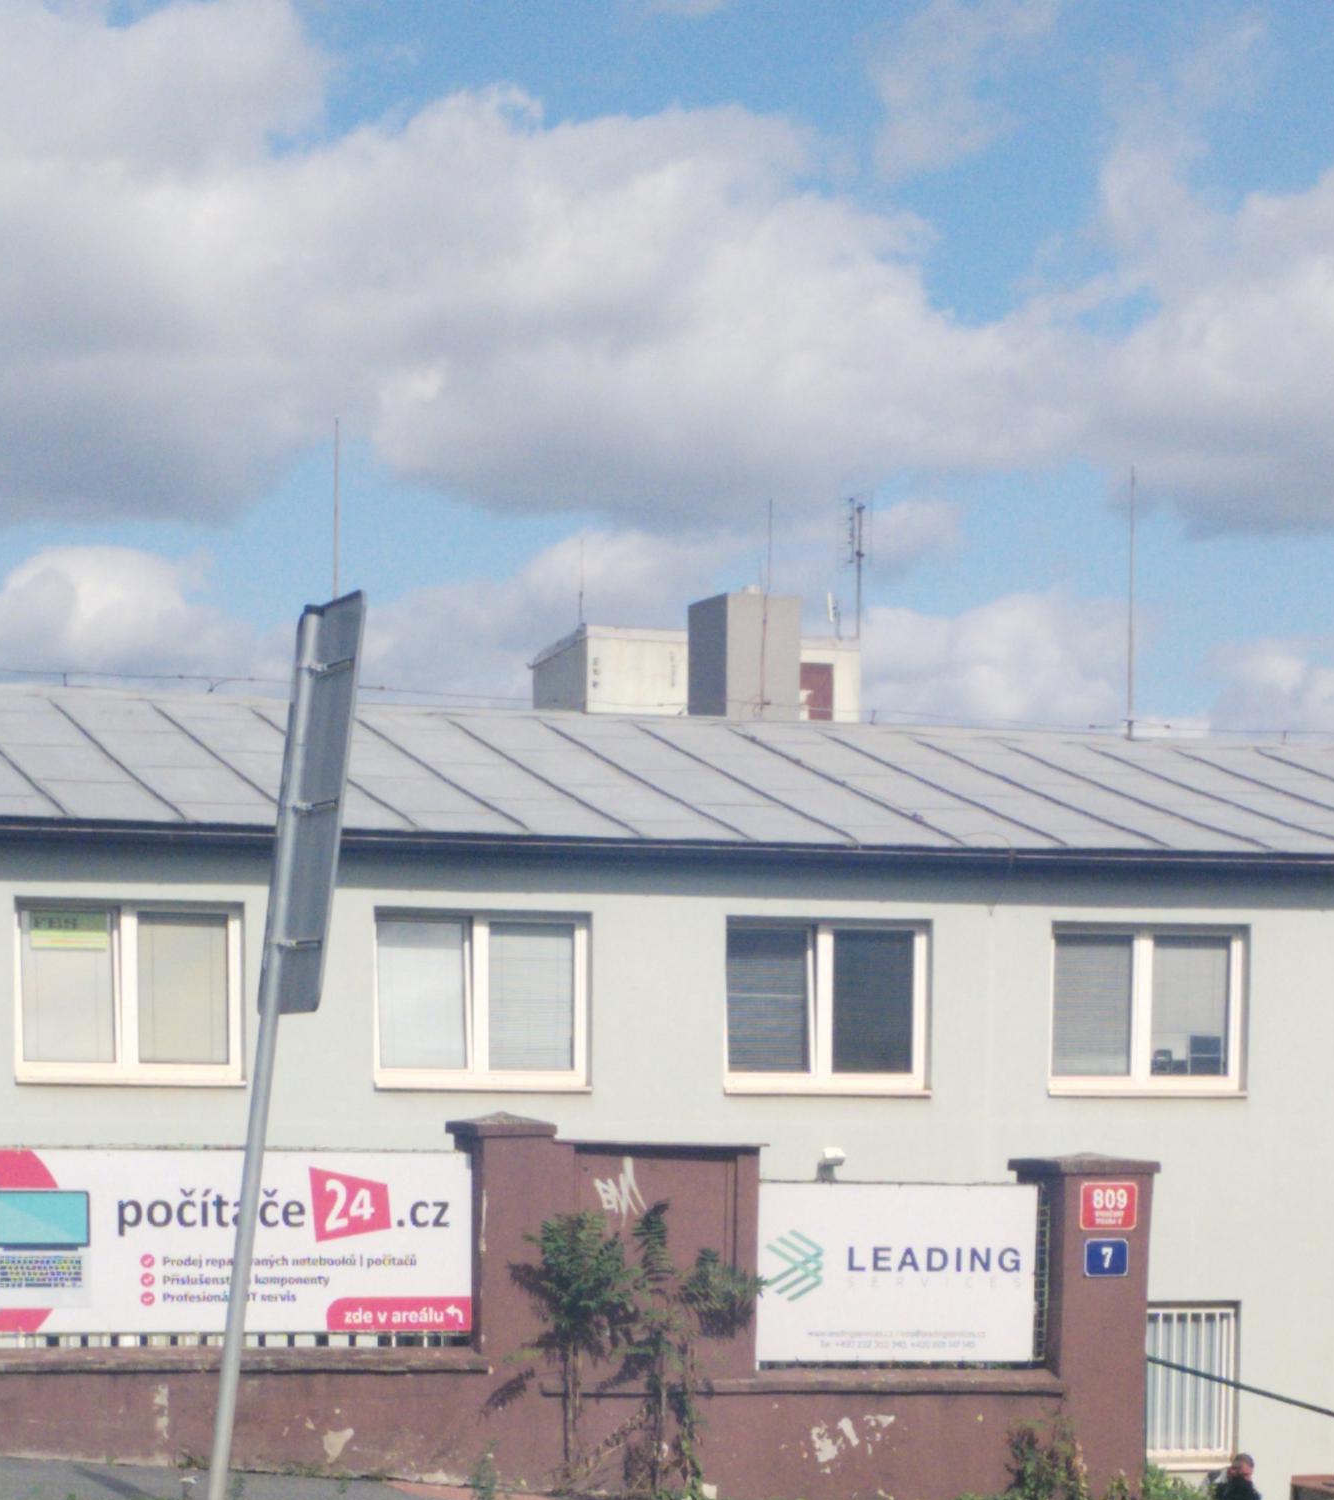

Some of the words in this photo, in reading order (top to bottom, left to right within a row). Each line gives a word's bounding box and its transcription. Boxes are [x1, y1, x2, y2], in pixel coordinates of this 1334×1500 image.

[1093, 1188, 1127, 1209] 809
[162, 1255, 203, 1269] Prodej
[847, 1246, 1022, 1272] LEADING
[1101, 1247, 1113, 1269] 7
[254, 1274, 330, 1287] komponenty
[344, 1307, 373, 1324] zde
[377, 1311, 387, 1324] v
[392, 1305, 444, 1324] areálu
